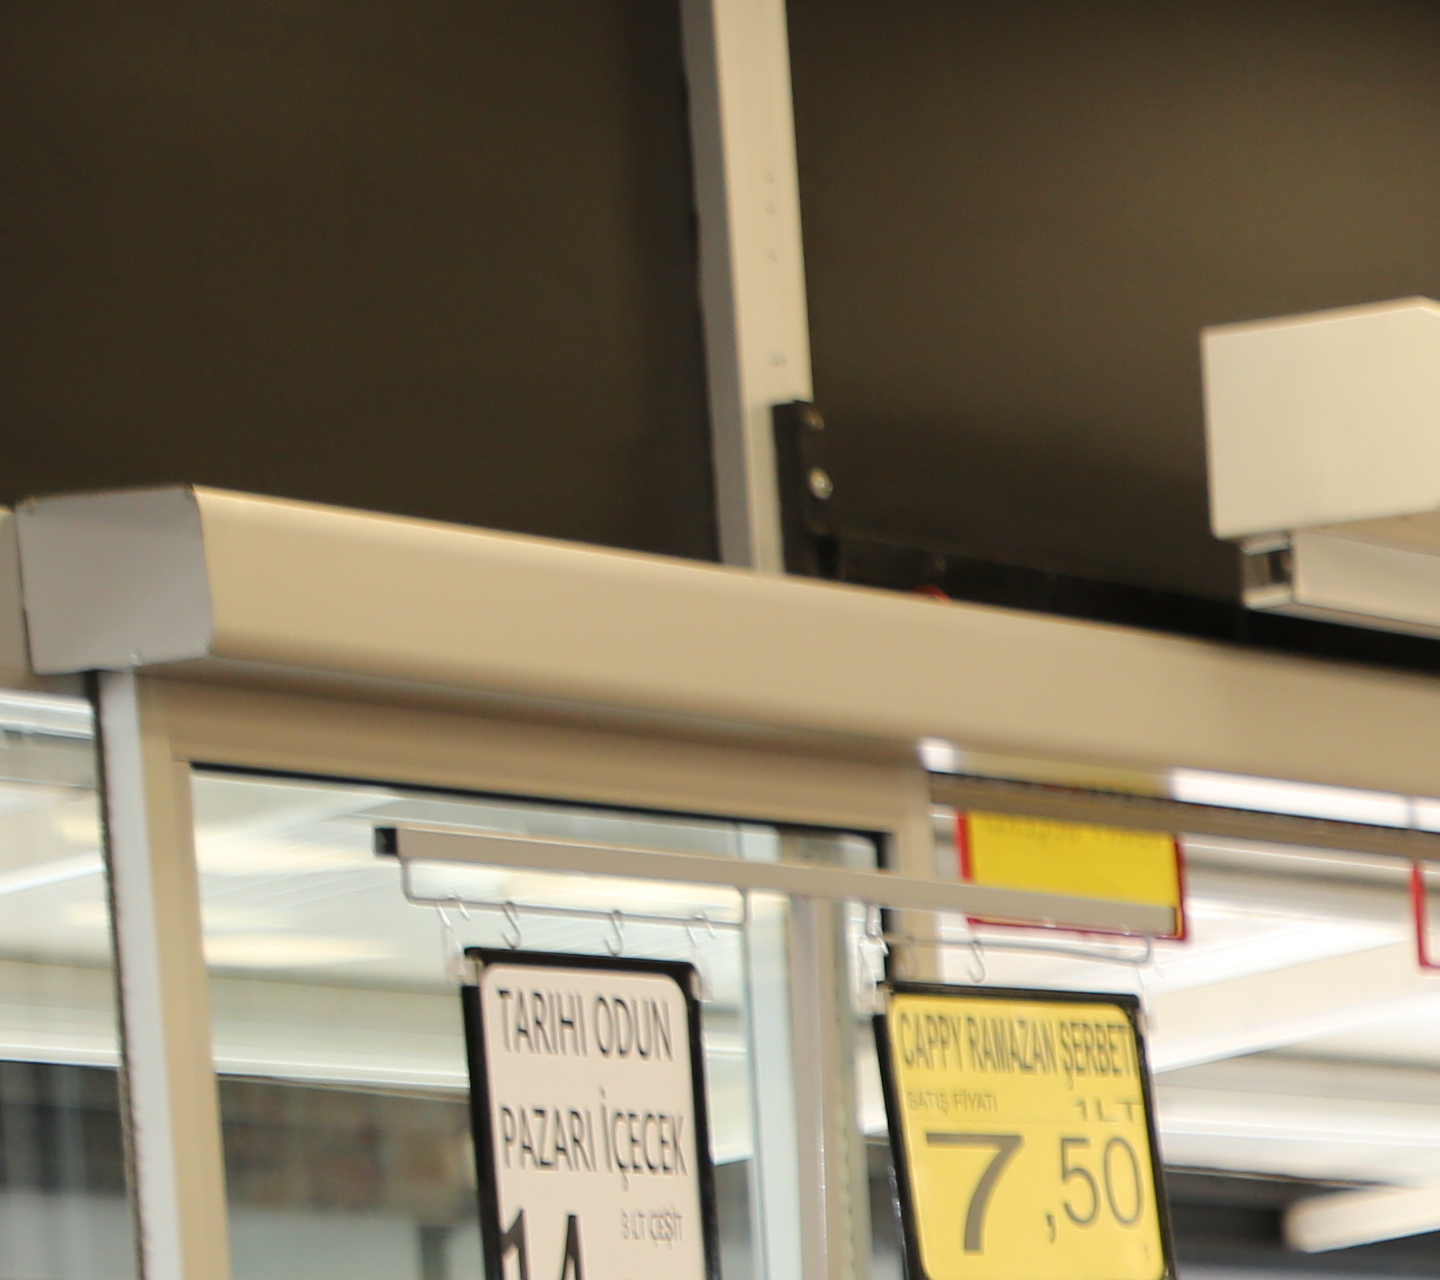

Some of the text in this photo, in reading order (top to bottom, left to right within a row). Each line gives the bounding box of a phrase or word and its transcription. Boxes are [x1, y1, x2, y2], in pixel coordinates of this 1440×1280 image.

[596, 995, 674, 1062] ODUN
[900, 1014, 1057, 1076] CAPPY RAMAZAN
[501, 1085, 688, 1191] PAZARI İÇECEK
